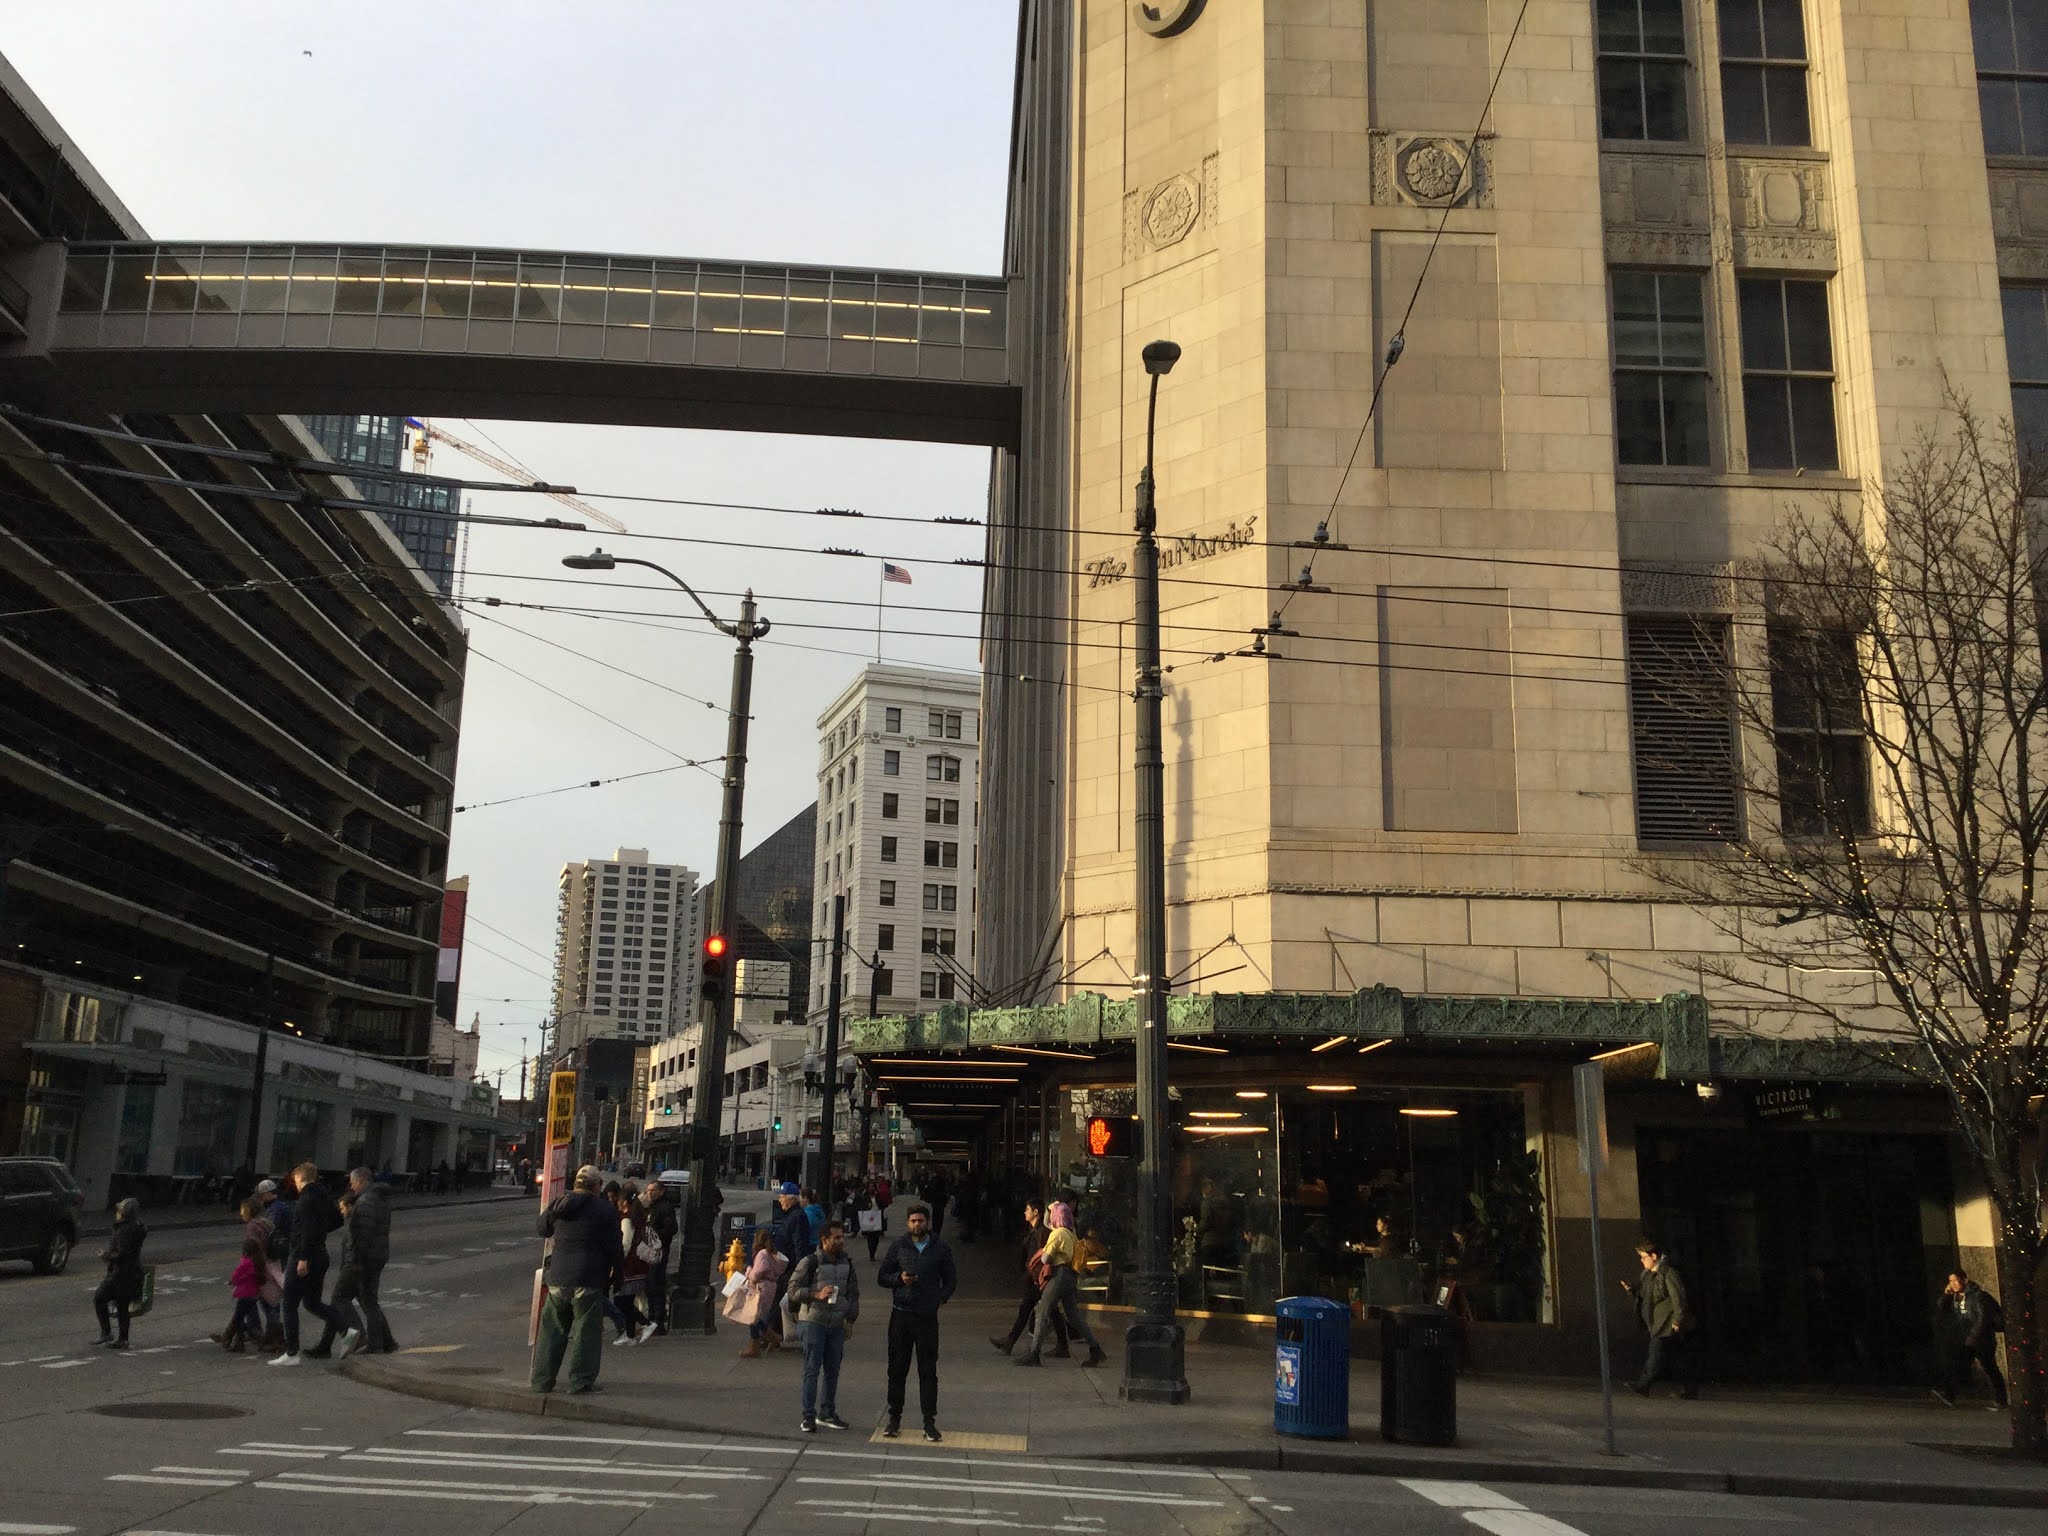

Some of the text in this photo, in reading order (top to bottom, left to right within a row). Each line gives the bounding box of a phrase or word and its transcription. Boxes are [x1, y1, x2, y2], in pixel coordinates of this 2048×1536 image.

[1085, 556, 1127, 588] The
[1174, 515, 1257, 565] Marché
[1755, 1088, 1811, 1106] VICTROLA
